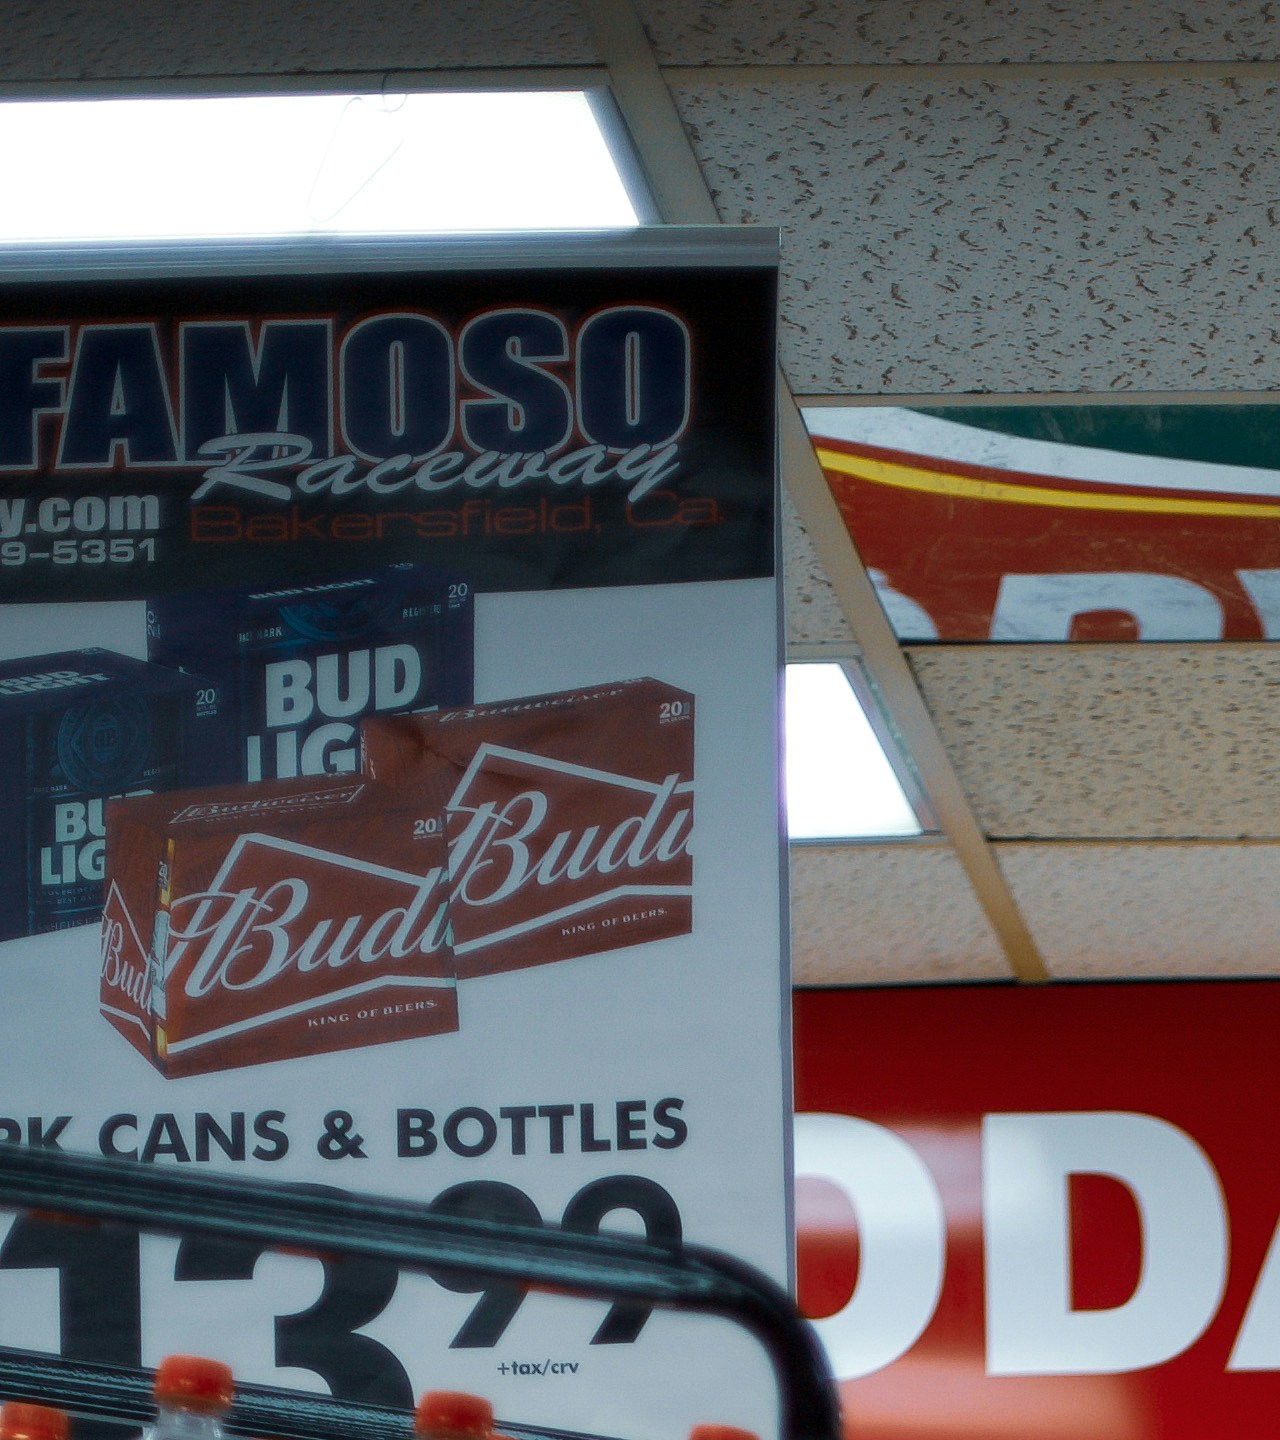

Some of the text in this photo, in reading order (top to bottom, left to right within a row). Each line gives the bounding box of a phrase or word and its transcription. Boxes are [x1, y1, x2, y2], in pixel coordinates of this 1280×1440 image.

[0, 305, 692, 470] FAMOSO
[191, 431, 681, 504] Raceway
[190, 496, 602, 543] Bakersfield,
[196, 688, 216, 706] 20
[265, 643, 422, 728] BUD
[659, 700, 683, 720] 20
[413, 817, 438, 837] 20
[40, 839, 106, 886] LIG
[560, 922, 596, 938] KING
[601, 917, 619, 929] OF
[306, 1013, 350, 1028] KING
[356, 1007, 379, 1020] OF
[98, 1109, 290, 1165] CANS
[316, 1108, 369, 1161] &
[397, 1097, 689, 1158] BOTTLES
[497, 1359, 581, 1378] +tax/crv
